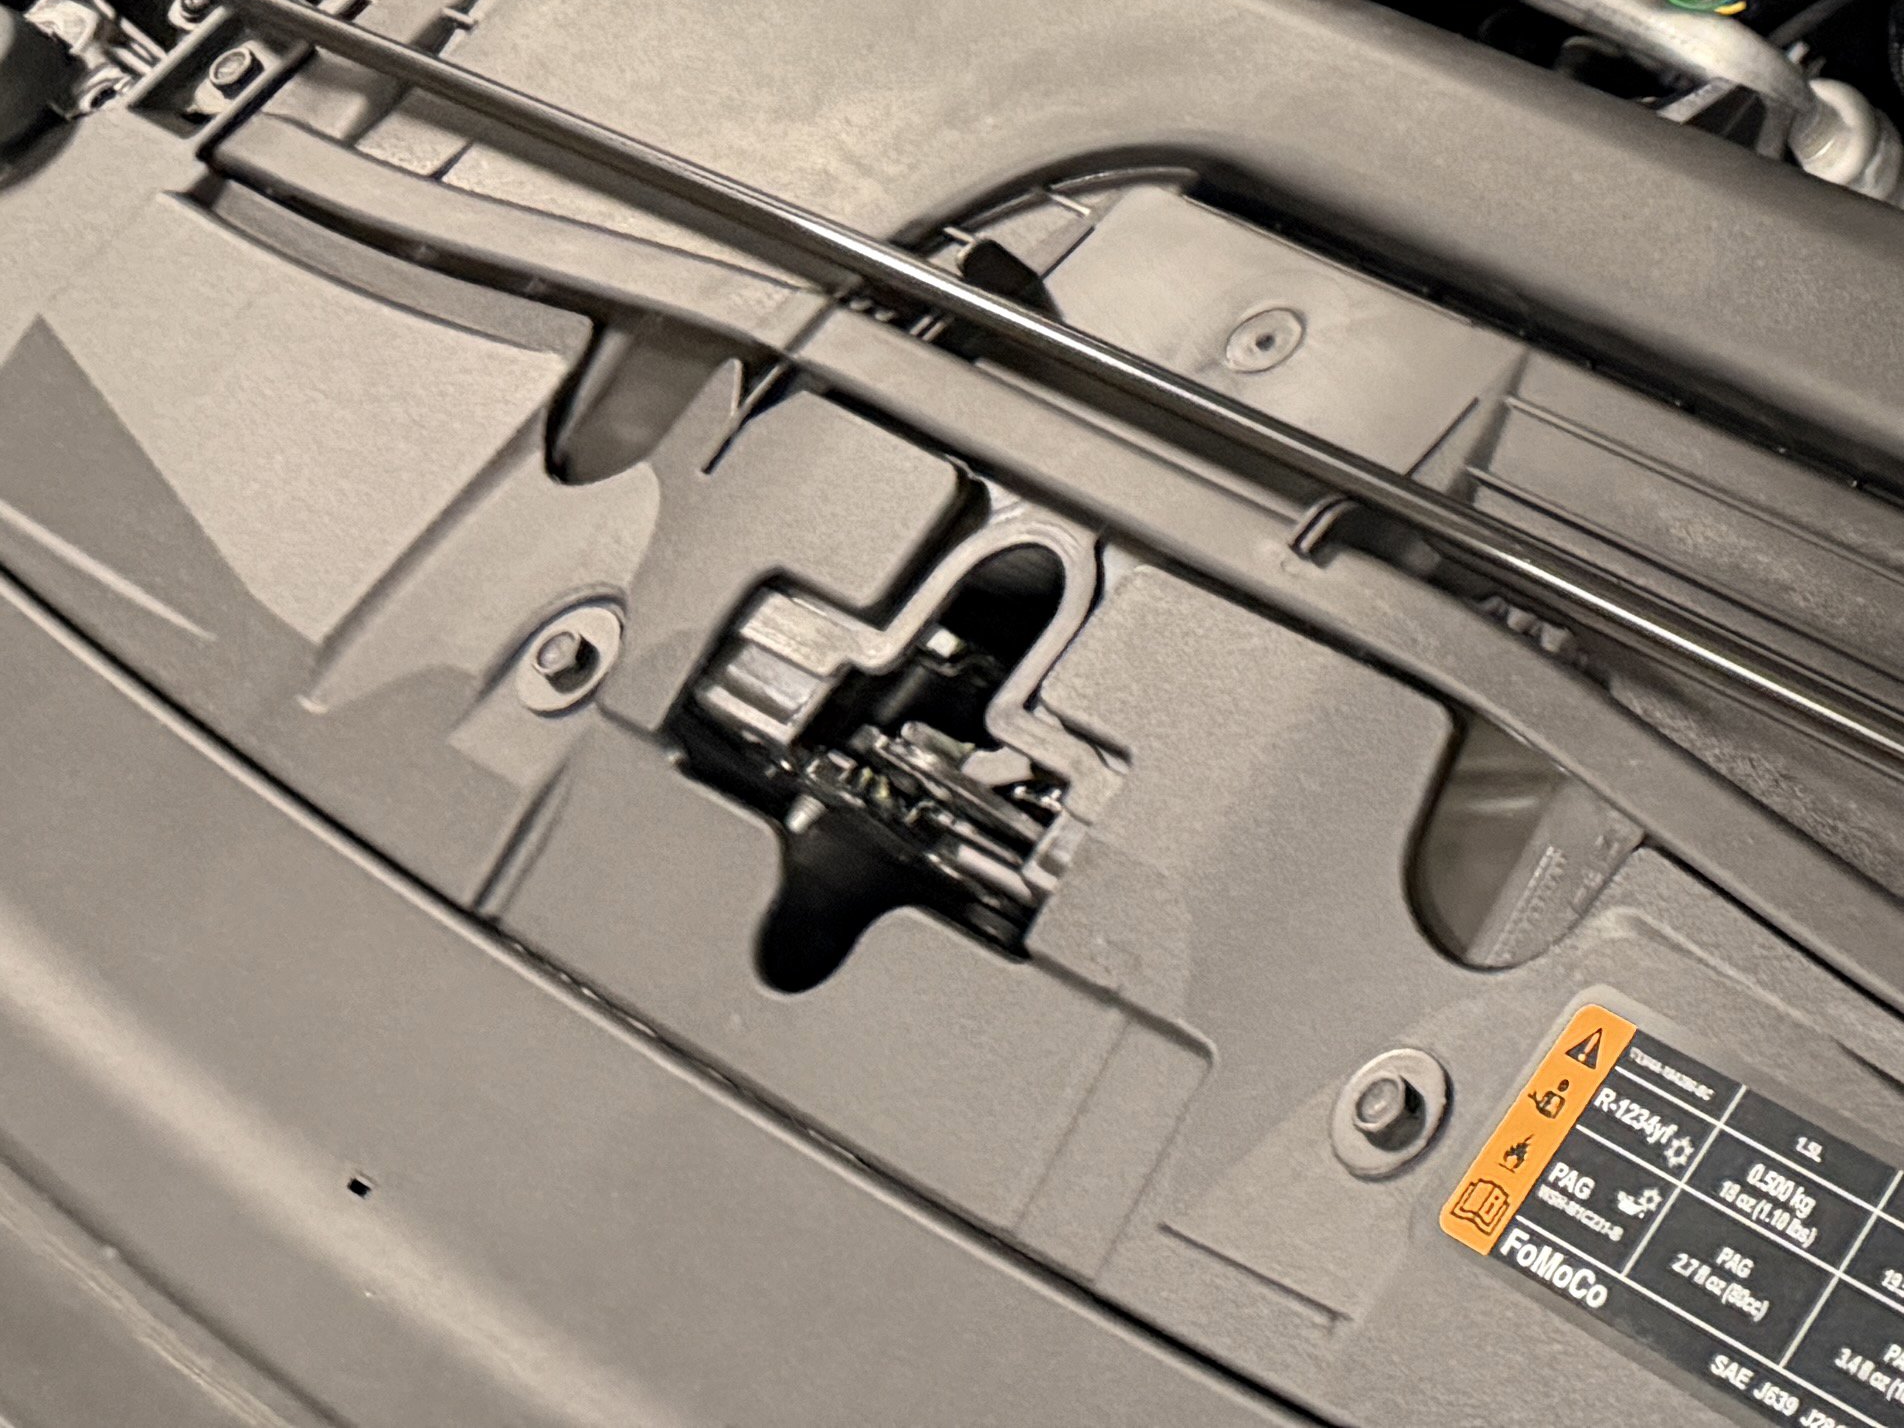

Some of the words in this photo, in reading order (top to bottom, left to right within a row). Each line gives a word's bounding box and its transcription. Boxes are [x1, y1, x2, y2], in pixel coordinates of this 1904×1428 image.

[1593, 1087, 1679, 1154] R-1234yf
[1547, 1161, 1595, 1200] PAG
[1746, 1163, 1796, 1202] 0.500
[1789, 1186, 1817, 1219] kg
[1735, 1193, 1757, 1213] oz
[1785, 1217, 1818, 1249] lbs)
[1499, 1227, 1608, 1308] FoMoCo
[1671, 1253, 1701, 1277] 2.7
[1704, 1275, 1727, 1296] oz
[1715, 1246, 1754, 1278] PAG
[1710, 1354, 1754, 1390] SAE
[1752, 1381, 1800, 1417] J639
[1834, 1348, 1863, 1375] 3.4
[1868, 1371, 1892, 1393] oz
